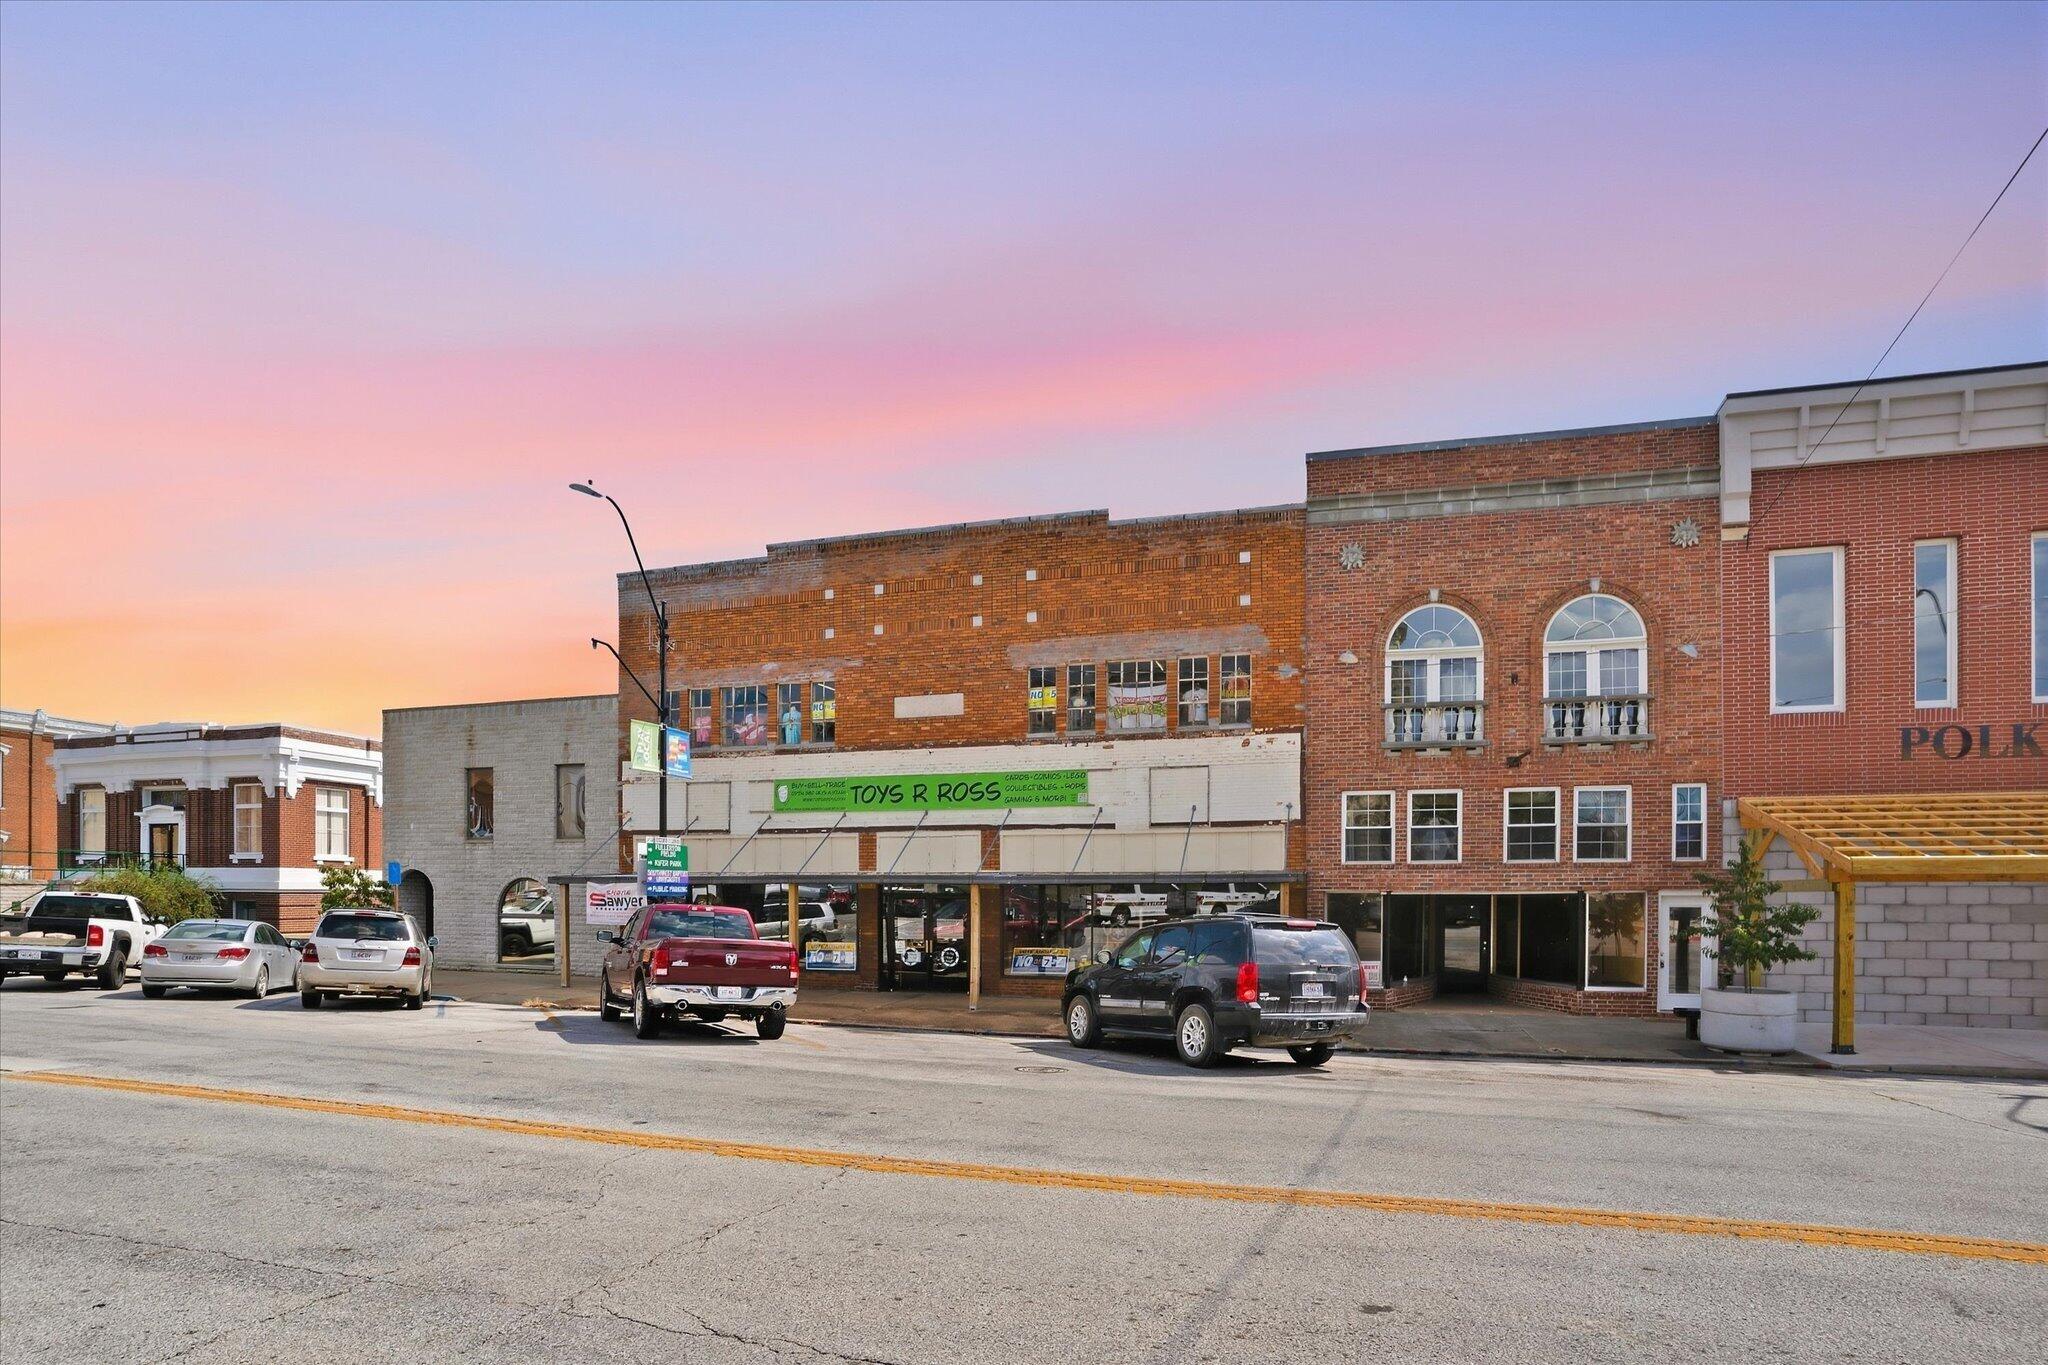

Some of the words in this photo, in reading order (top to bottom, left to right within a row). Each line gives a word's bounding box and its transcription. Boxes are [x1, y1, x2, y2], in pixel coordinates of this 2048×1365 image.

[1897, 723, 2045, 760] POLK
[850, 784, 904, 804] TOYS
[912, 783, 928, 803] R
[937, 781, 1001, 802] ROSS
[590, 893, 644, 910] Sawyer
[1014, 955, 1034, 967] NO
